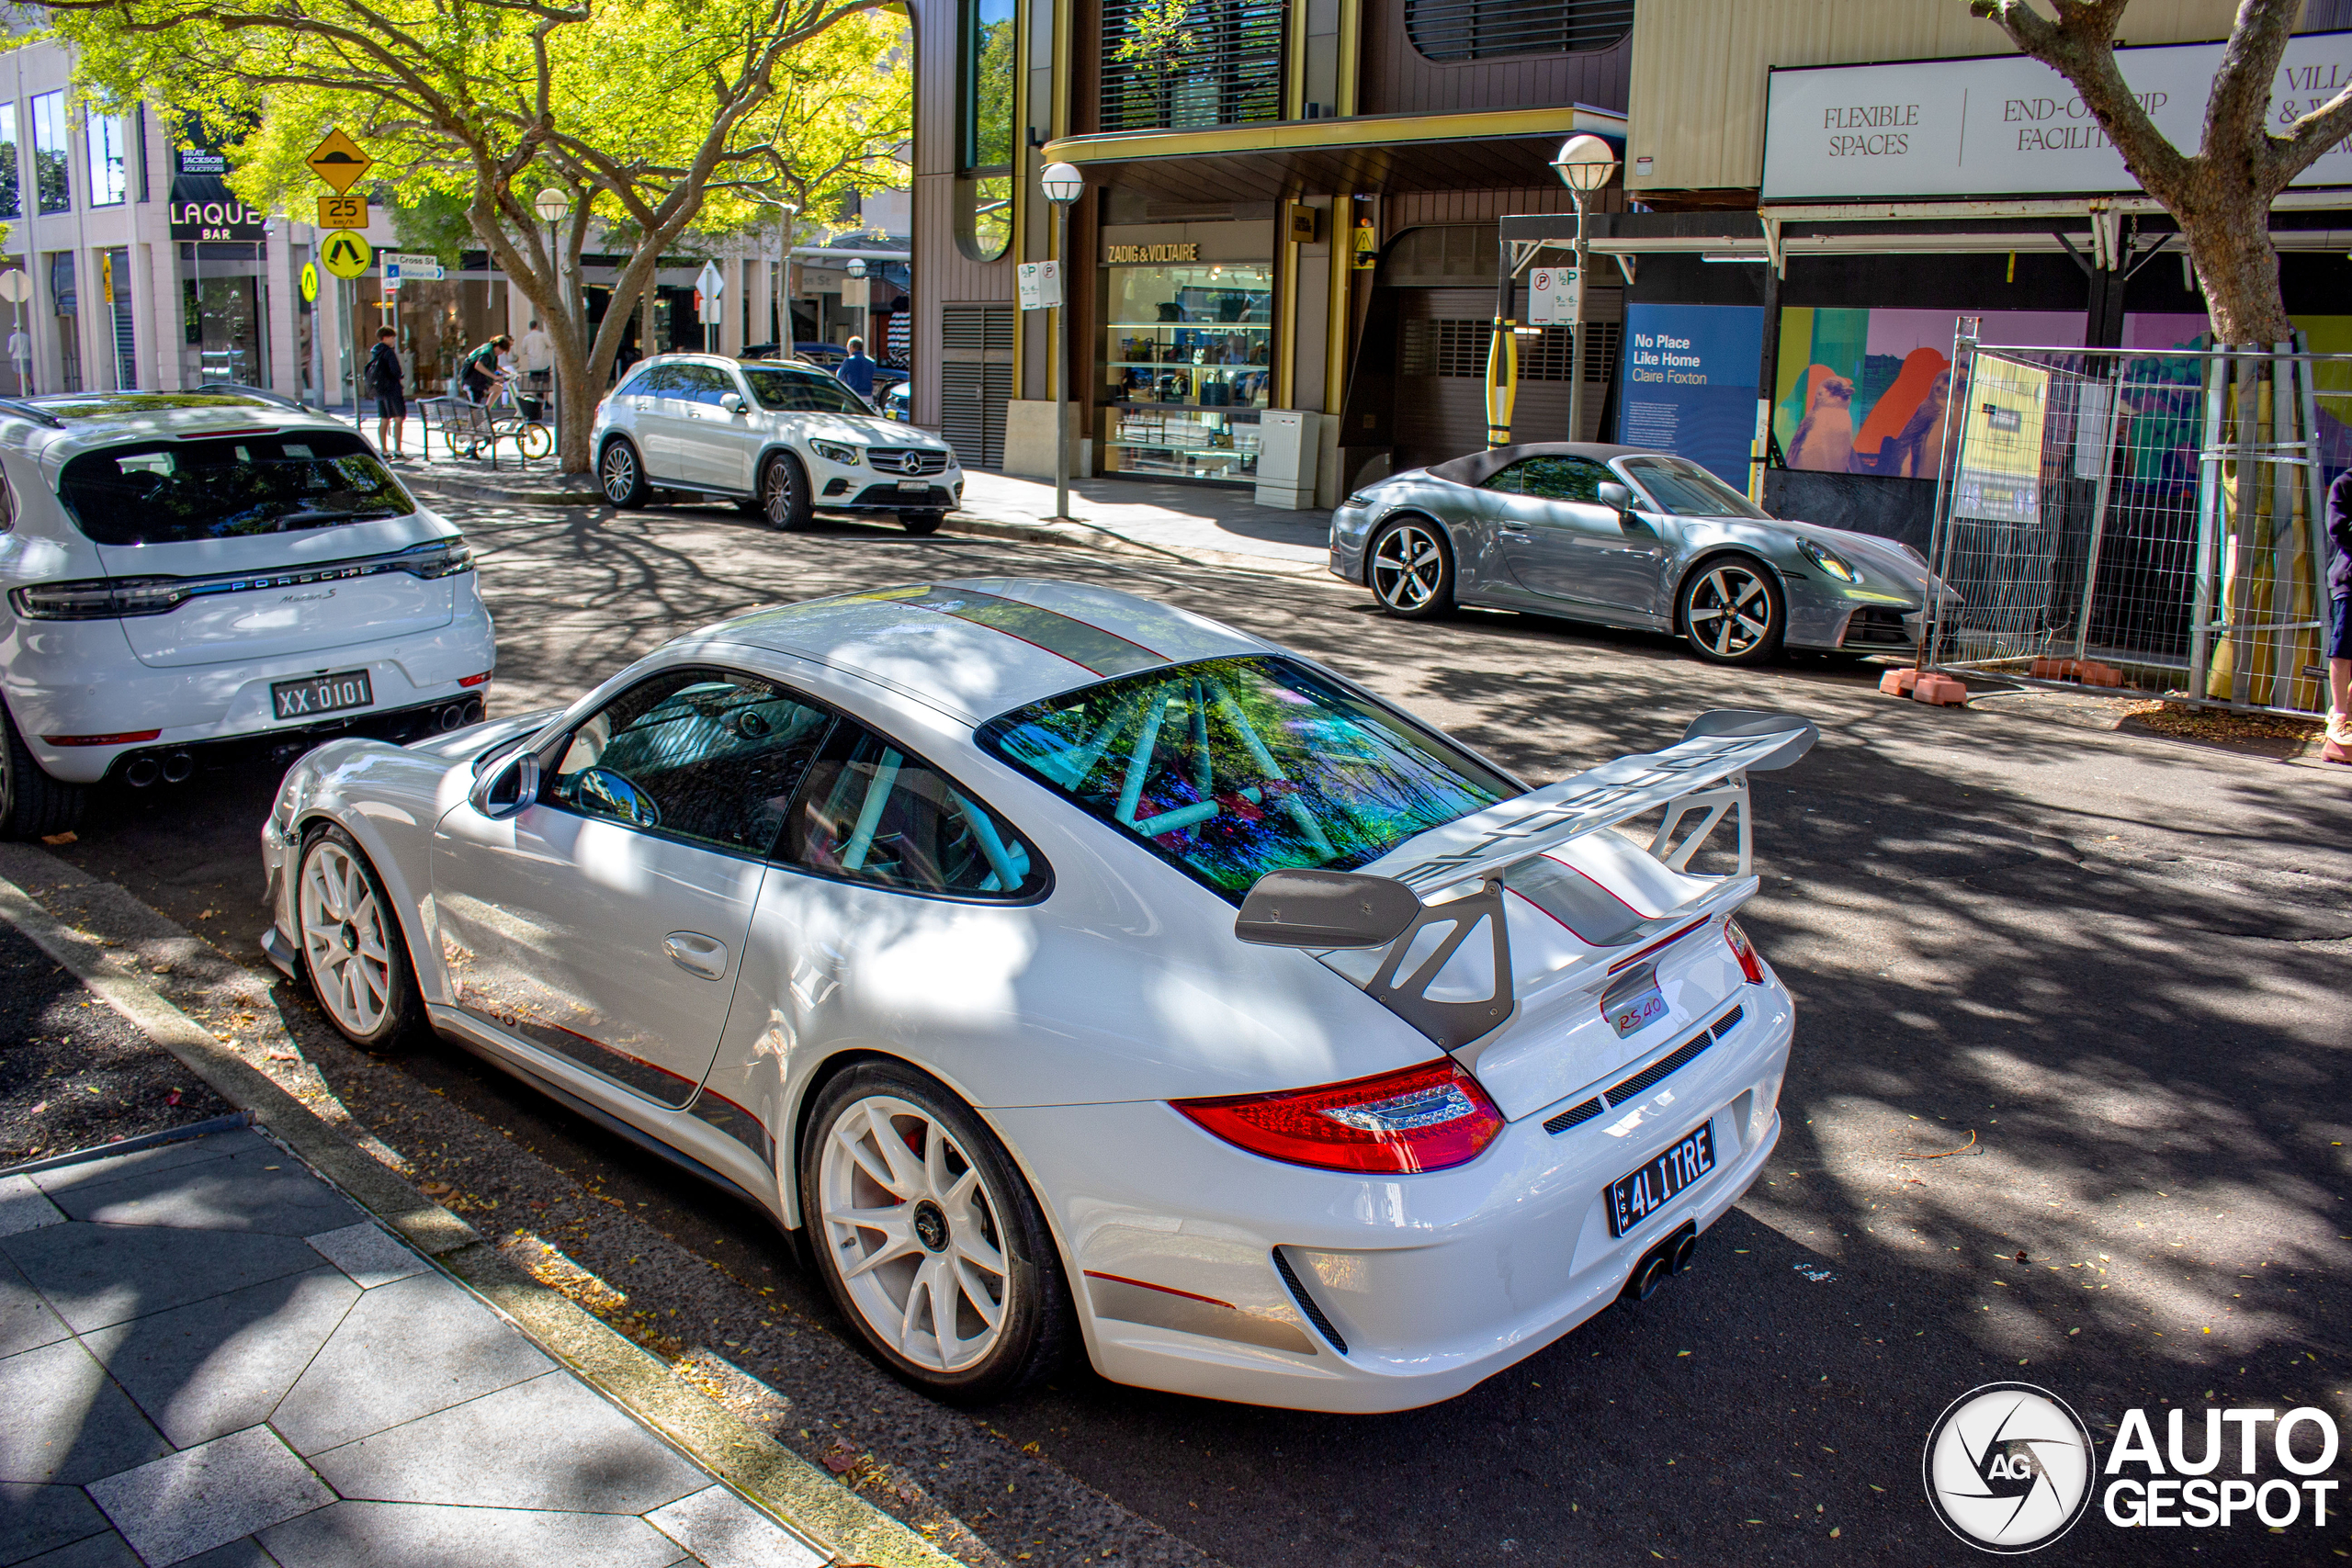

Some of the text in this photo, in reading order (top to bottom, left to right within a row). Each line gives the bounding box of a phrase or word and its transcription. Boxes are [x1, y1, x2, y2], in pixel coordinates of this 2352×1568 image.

[1823, 104, 1919, 130] FLEXIBLE
[1827, 133, 1909, 157] SPACES
[182, 156, 224, 164] JACKSON
[170, 202, 261, 226] LAQUE
[329, 199, 357, 217] 25
[202, 228, 232, 240] BAR
[399, 255, 435, 265] Cross St
[1634, 333, 1690, 349] No Place
[1633, 351, 1701, 367] Like Home
[1632, 367, 1707, 385] Claire Foxton
[231, 566, 373, 592] PORSCHE
[277, 592, 322, 605] Macan
[312, 678, 332, 686] NSW
[1618, 998, 1661, 1032] RS 4.0
[1632, 1128, 1711, 1217] 4LITRE
[1618, 1187, 1629, 1227] NSW
